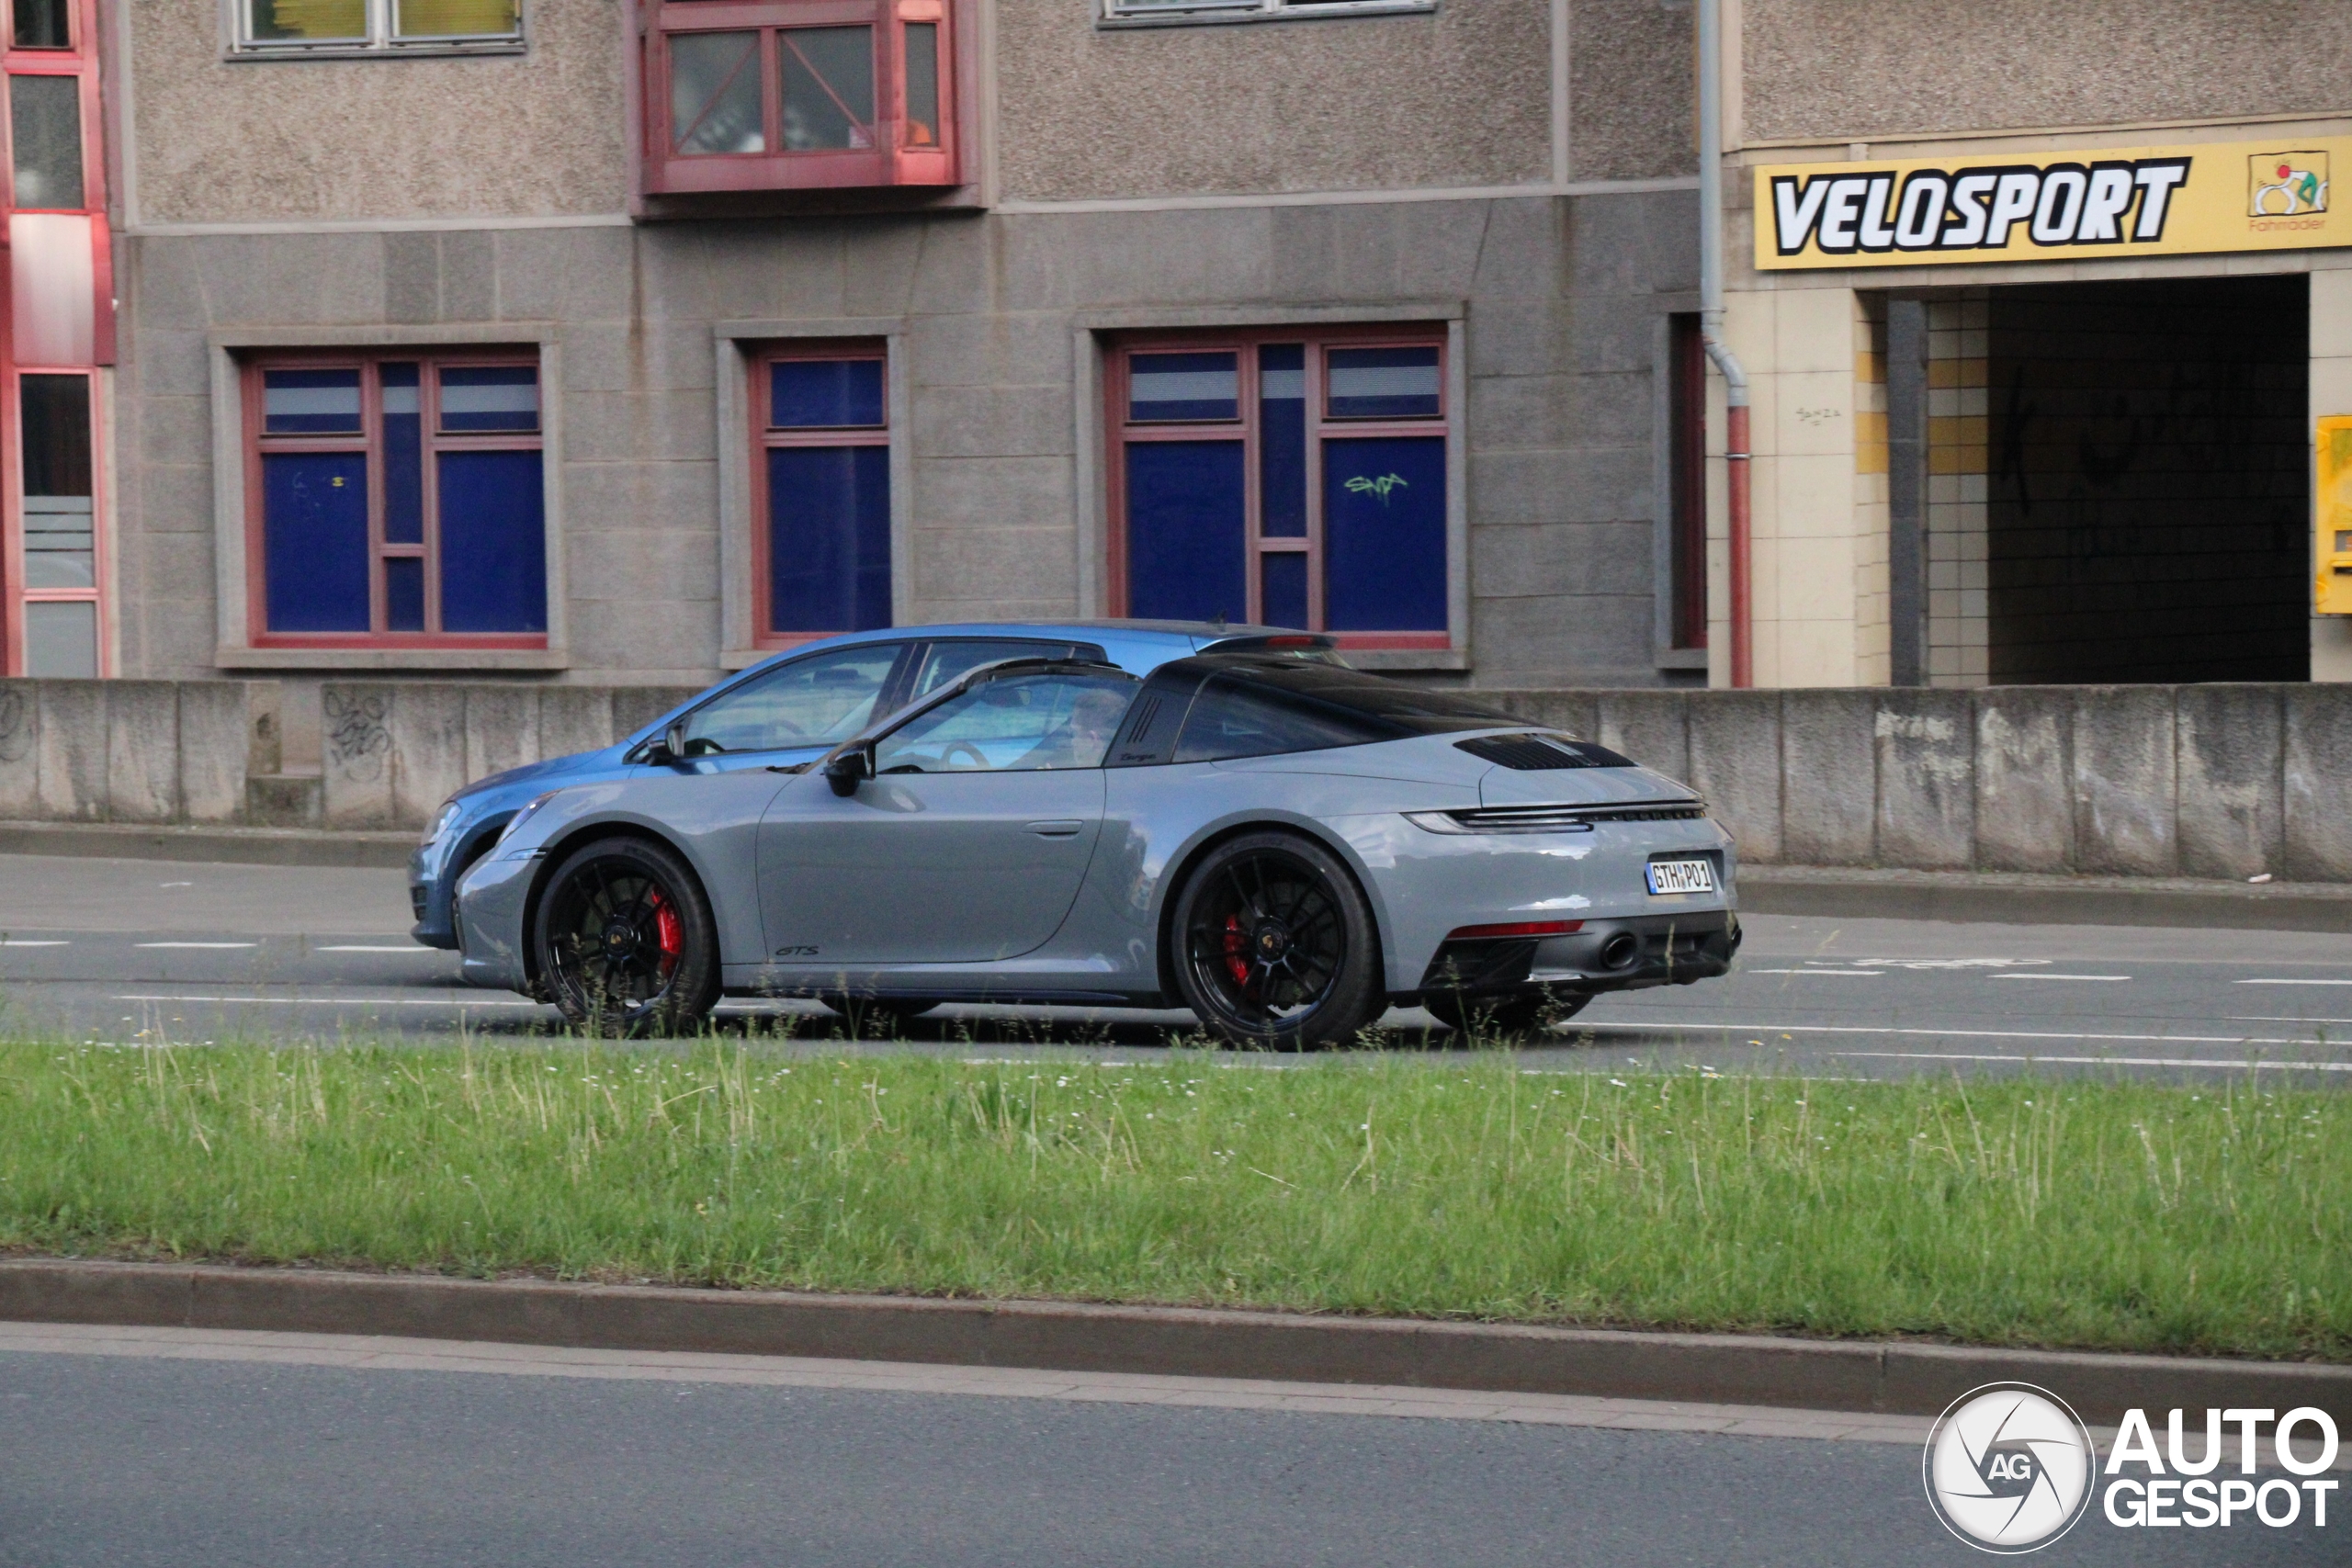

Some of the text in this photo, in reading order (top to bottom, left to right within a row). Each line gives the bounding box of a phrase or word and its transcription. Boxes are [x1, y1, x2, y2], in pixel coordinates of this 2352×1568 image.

[1771, 157, 2191, 255] VELOSPORT
[1653, 864, 1680, 888] GTH
[775, 945, 819, 956] GTS
